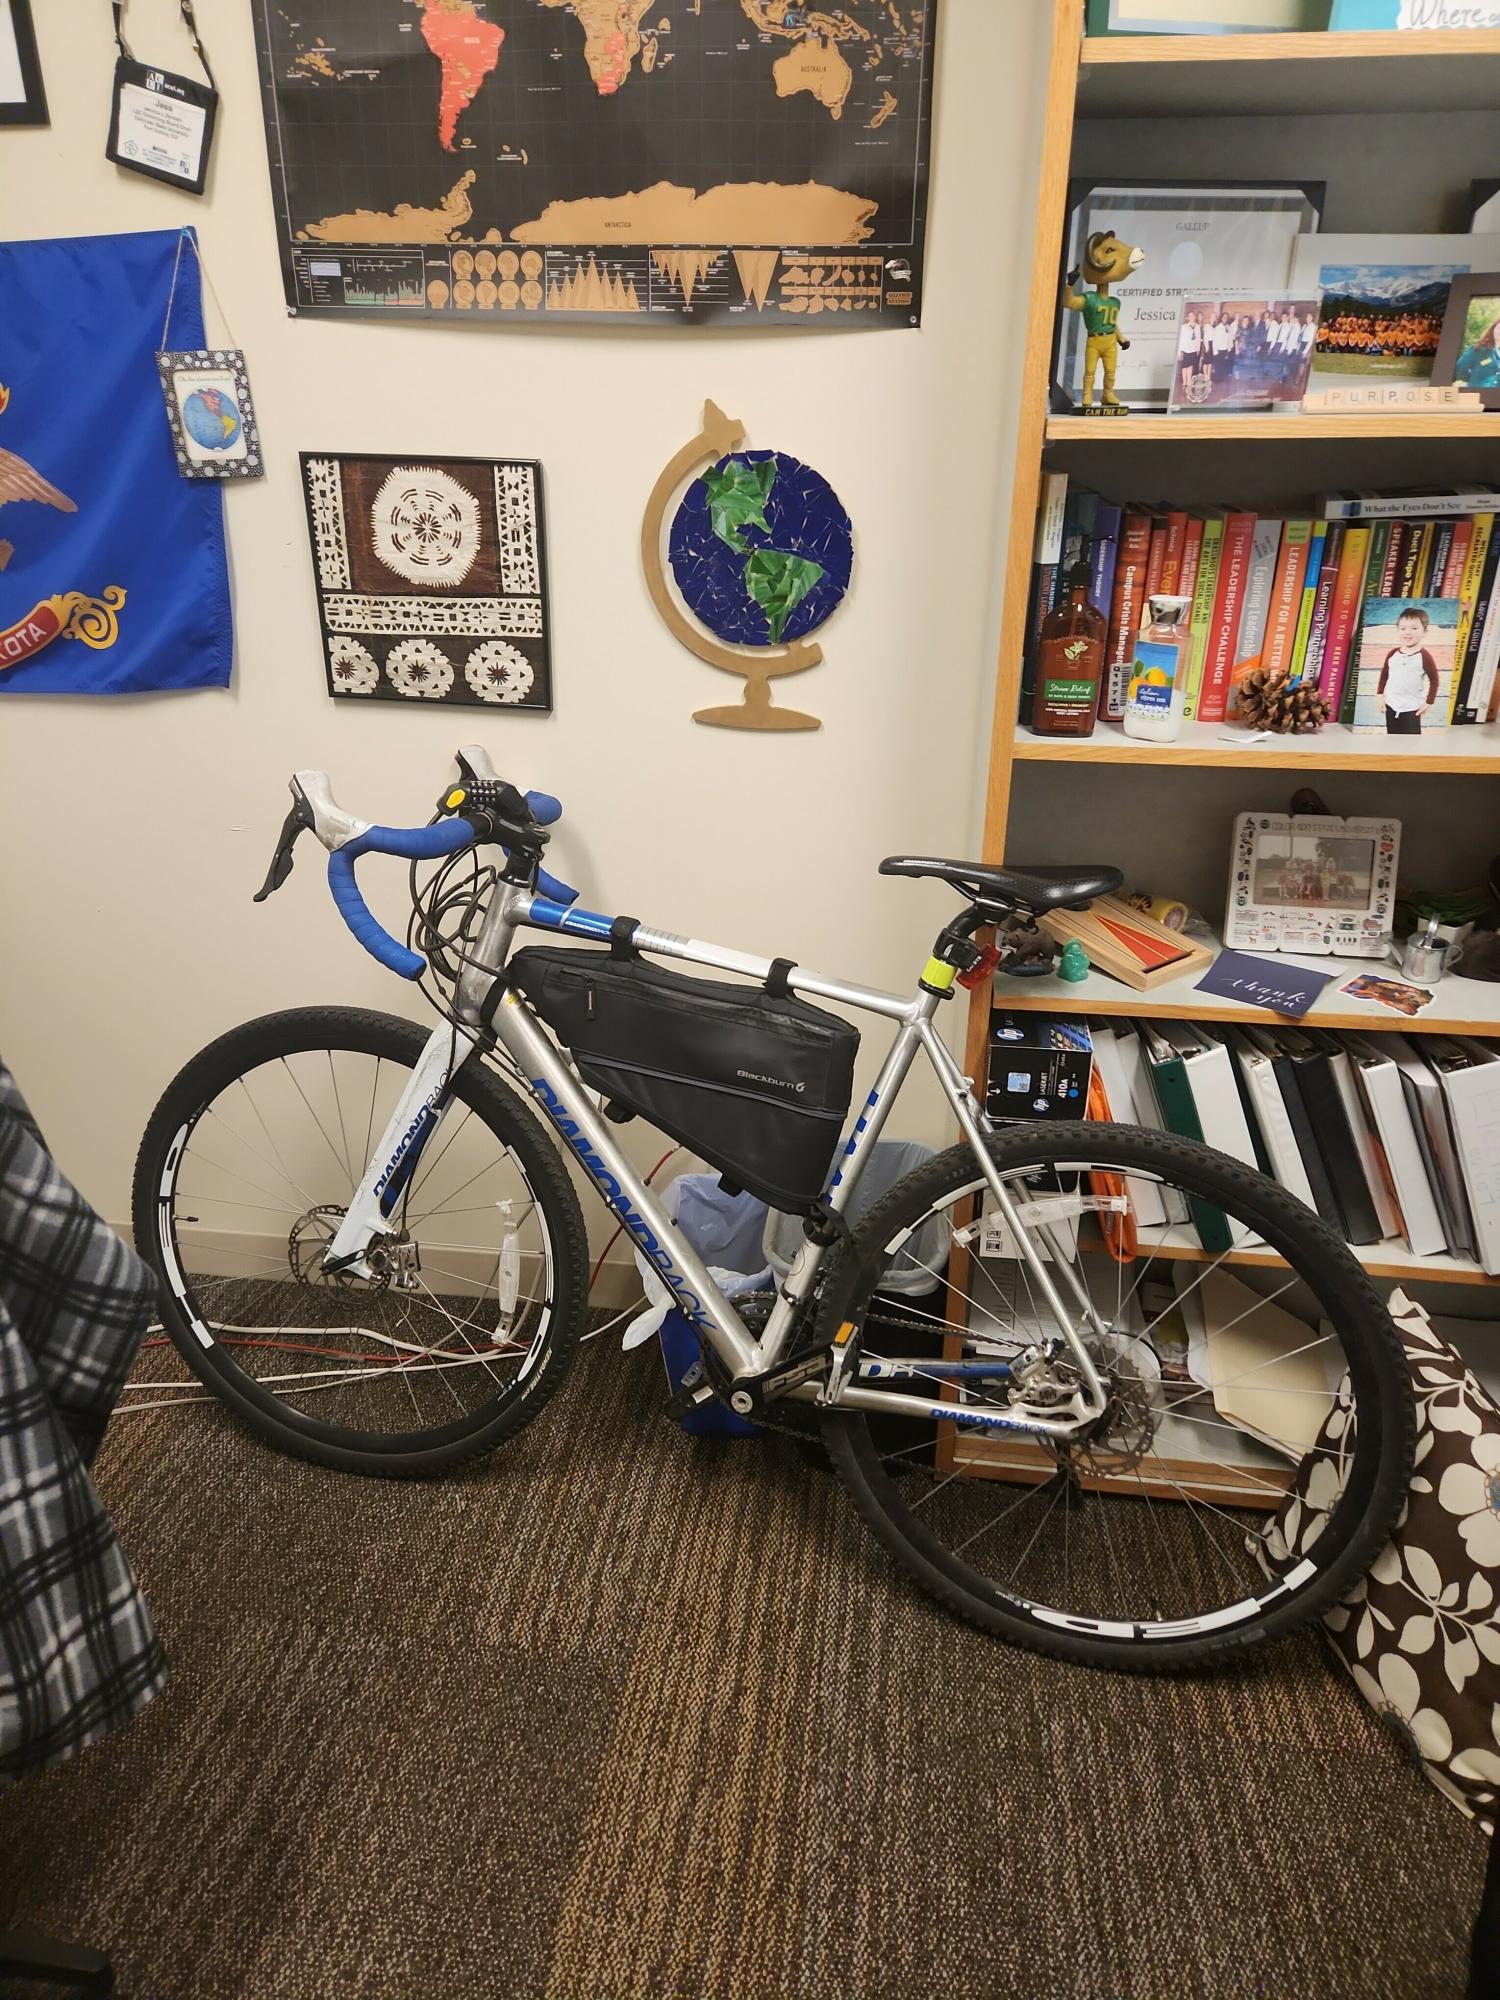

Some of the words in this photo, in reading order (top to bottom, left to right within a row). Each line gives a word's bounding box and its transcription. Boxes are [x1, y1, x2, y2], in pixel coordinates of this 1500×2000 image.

[1410, 0, 1486, 26] Where
[1175, 222, 1210, 231] GALLUP
[1117, 288, 1163, 297] CERTIFIED
[1134, 306, 1177, 321] Jessica
[1332, 391, 1455, 403] PURPOSE
[1085, 408, 1101, 416] CAM
[1102, 408, 1117, 416] THE
[1365, 505, 1388, 513] What
[1402, 504, 1421, 513] Eyes
[1422, 503, 1446, 511] Don't
[1447, 502, 1462, 510] See
[1168, 526, 1178, 552] Schmitz
[1203, 538, 1211, 549] THE
[1233, 536, 1244, 556] THE
[1386, 527, 1402, 571] SPEAKER
[1410, 530, 1422, 553] Duct
[1470, 527, 1483, 565] ESCALATED
[1201, 551, 1210, 566] ARTS
[1208, 537, 1220, 575] GRASSROOTS
[1440, 532, 1452, 571] LEADERSHIP
[1160, 560, 1177, 595] Ever
[1281, 547, 1301, 605] LEADERSHIP
[1404, 555, 1417, 579] Tape
[1464, 565, 1475, 592] QUICKLY
[1475, 560, 1484, 577] THAT
[1043, 566, 1052, 595] STUDENT
[1095, 574, 1104, 597] THEORY
[1122, 565, 1137, 599] Campus
[1196, 581, 1205, 601] SOCIAL
[1223, 558, 1241, 623] LEADERSHIP
[1247, 566, 1268, 608] Exploring
[1380, 572, 1394, 598] LEADE
[1401, 581, 1412, 598] Tea
[1203, 576, 1213, 611] LEADERSHIP
[1314, 581, 1333, 622] Learning
[1119, 600, 1132, 626] Crisis
[1193, 602, 1202, 624] CHANGE
[1278, 605, 1290, 623] FOR
[1340, 610, 1349, 620] TO
[1240, 610, 1261, 657] Leadership
[1336, 624, 1346, 640] YOU
[1213, 625, 1231, 685] CHALLENGE
[1271, 633, 1286, 668] BETTER
[1307, 623, 1325, 680] Partnerships
[1331, 647, 1342, 665] KEKE
[1049, 683, 1070, 692] Stress
[1070, 685, 1092, 695] Relief
[1327, 668, 1338, 697] PALMER
[1224, 979, 1308, 1003] thank
[1256, 995, 1296, 1009] you
[736, 1069, 795, 1089] Blackburn
[1040, 1072, 1048, 1096] LASERJET
[1058, 1079, 1069, 1099] 410A
[1035, 1099, 1048, 1111] hp
[531, 1078, 718, 1330] DIAMONDBACK
[929, 1407, 1050, 1436] DIAMONDBACK
